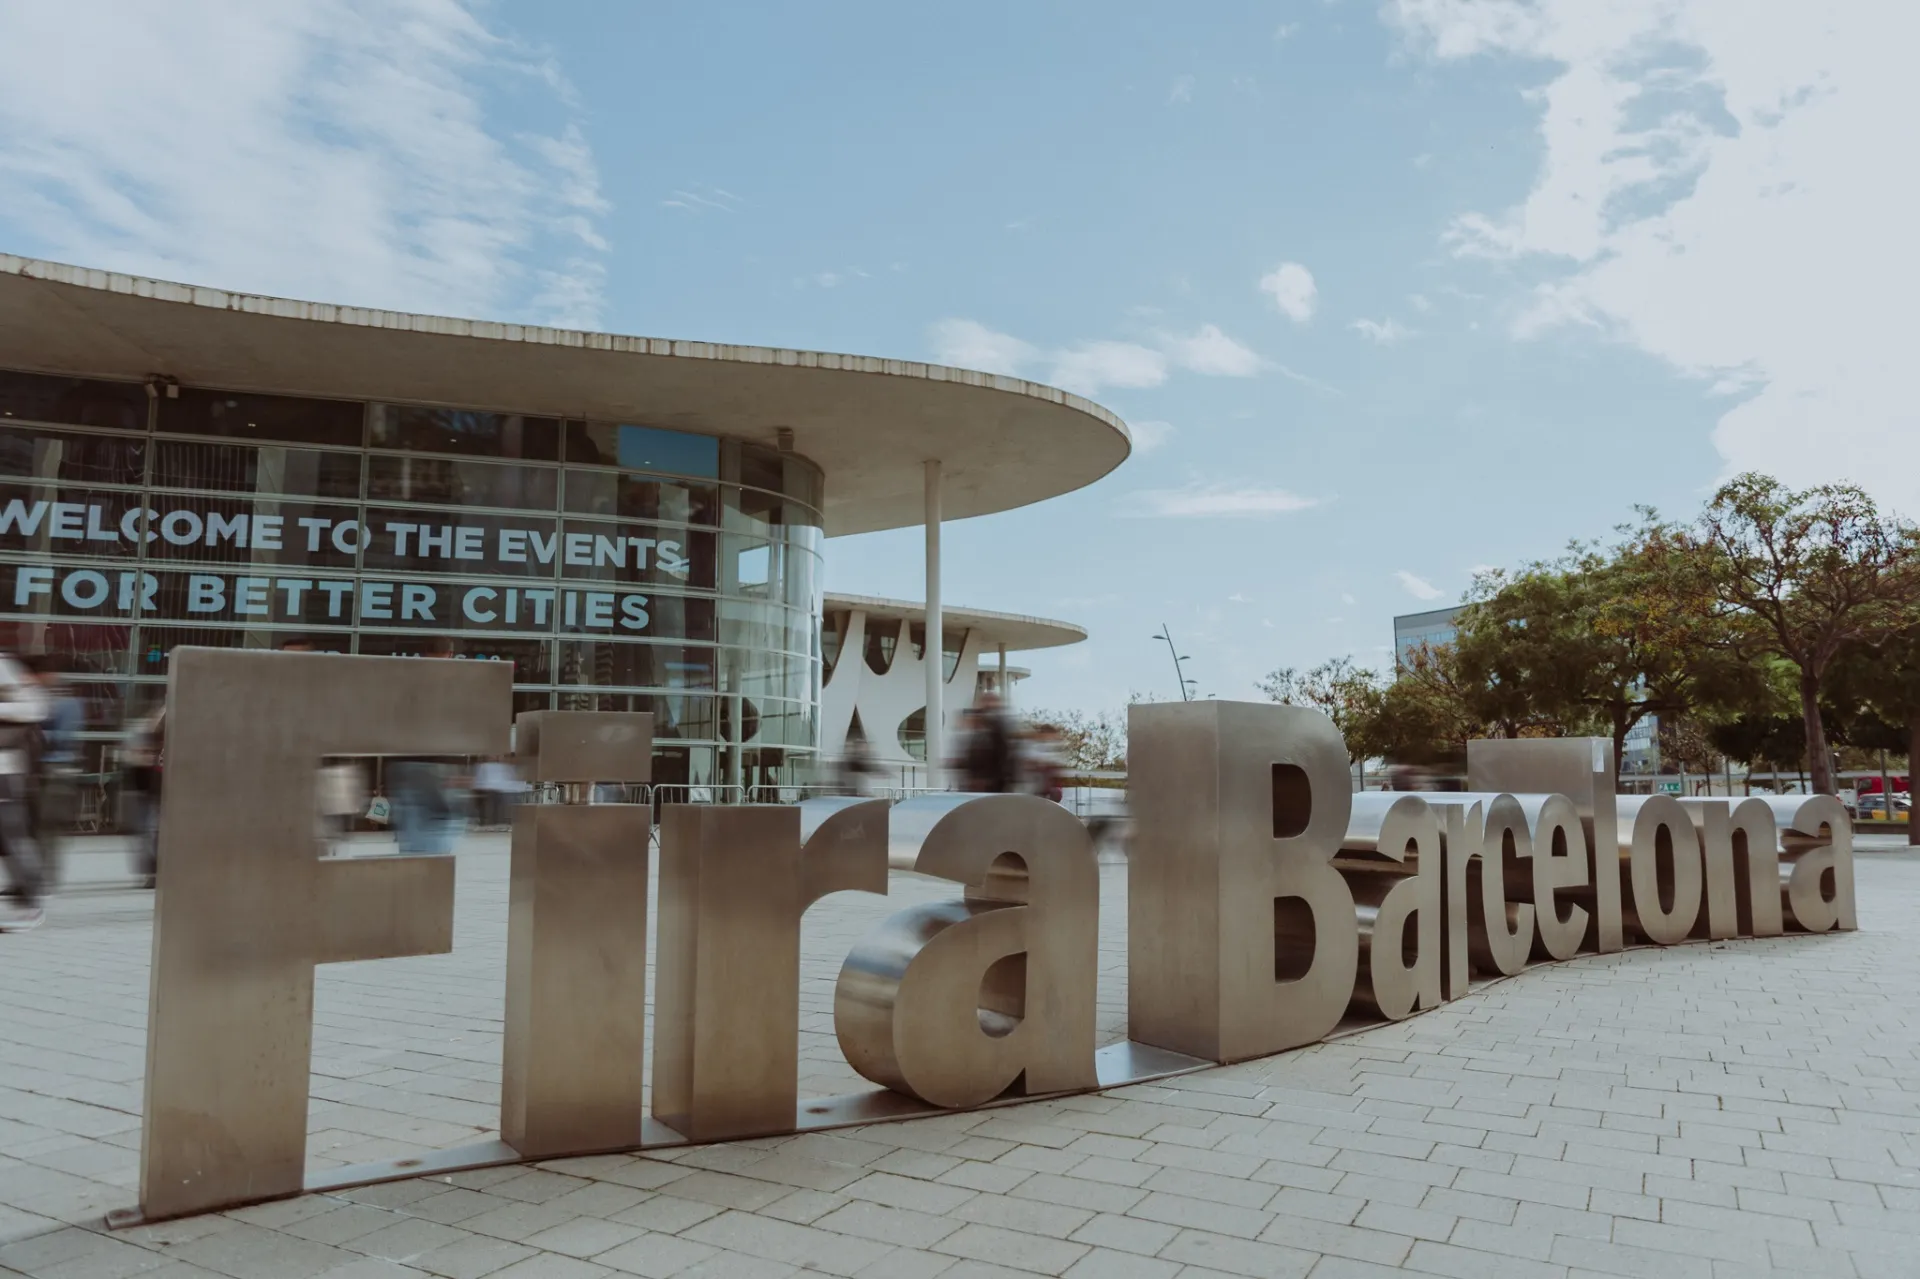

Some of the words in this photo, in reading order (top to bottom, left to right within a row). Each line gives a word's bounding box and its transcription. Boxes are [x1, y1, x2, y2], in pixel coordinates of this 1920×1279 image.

[0, 498, 284, 549] WELCOME
[298, 518, 371, 554] TO
[386, 523, 485, 560] THE
[499, 529, 681, 574] EVENTS
[15, 567, 158, 611] FOR
[188, 574, 436, 621] BETTER
[462, 586, 650, 629] CITIES
[139, 645, 1099, 1218] Fira
[1128, 699, 1856, 1063] Barcelona
